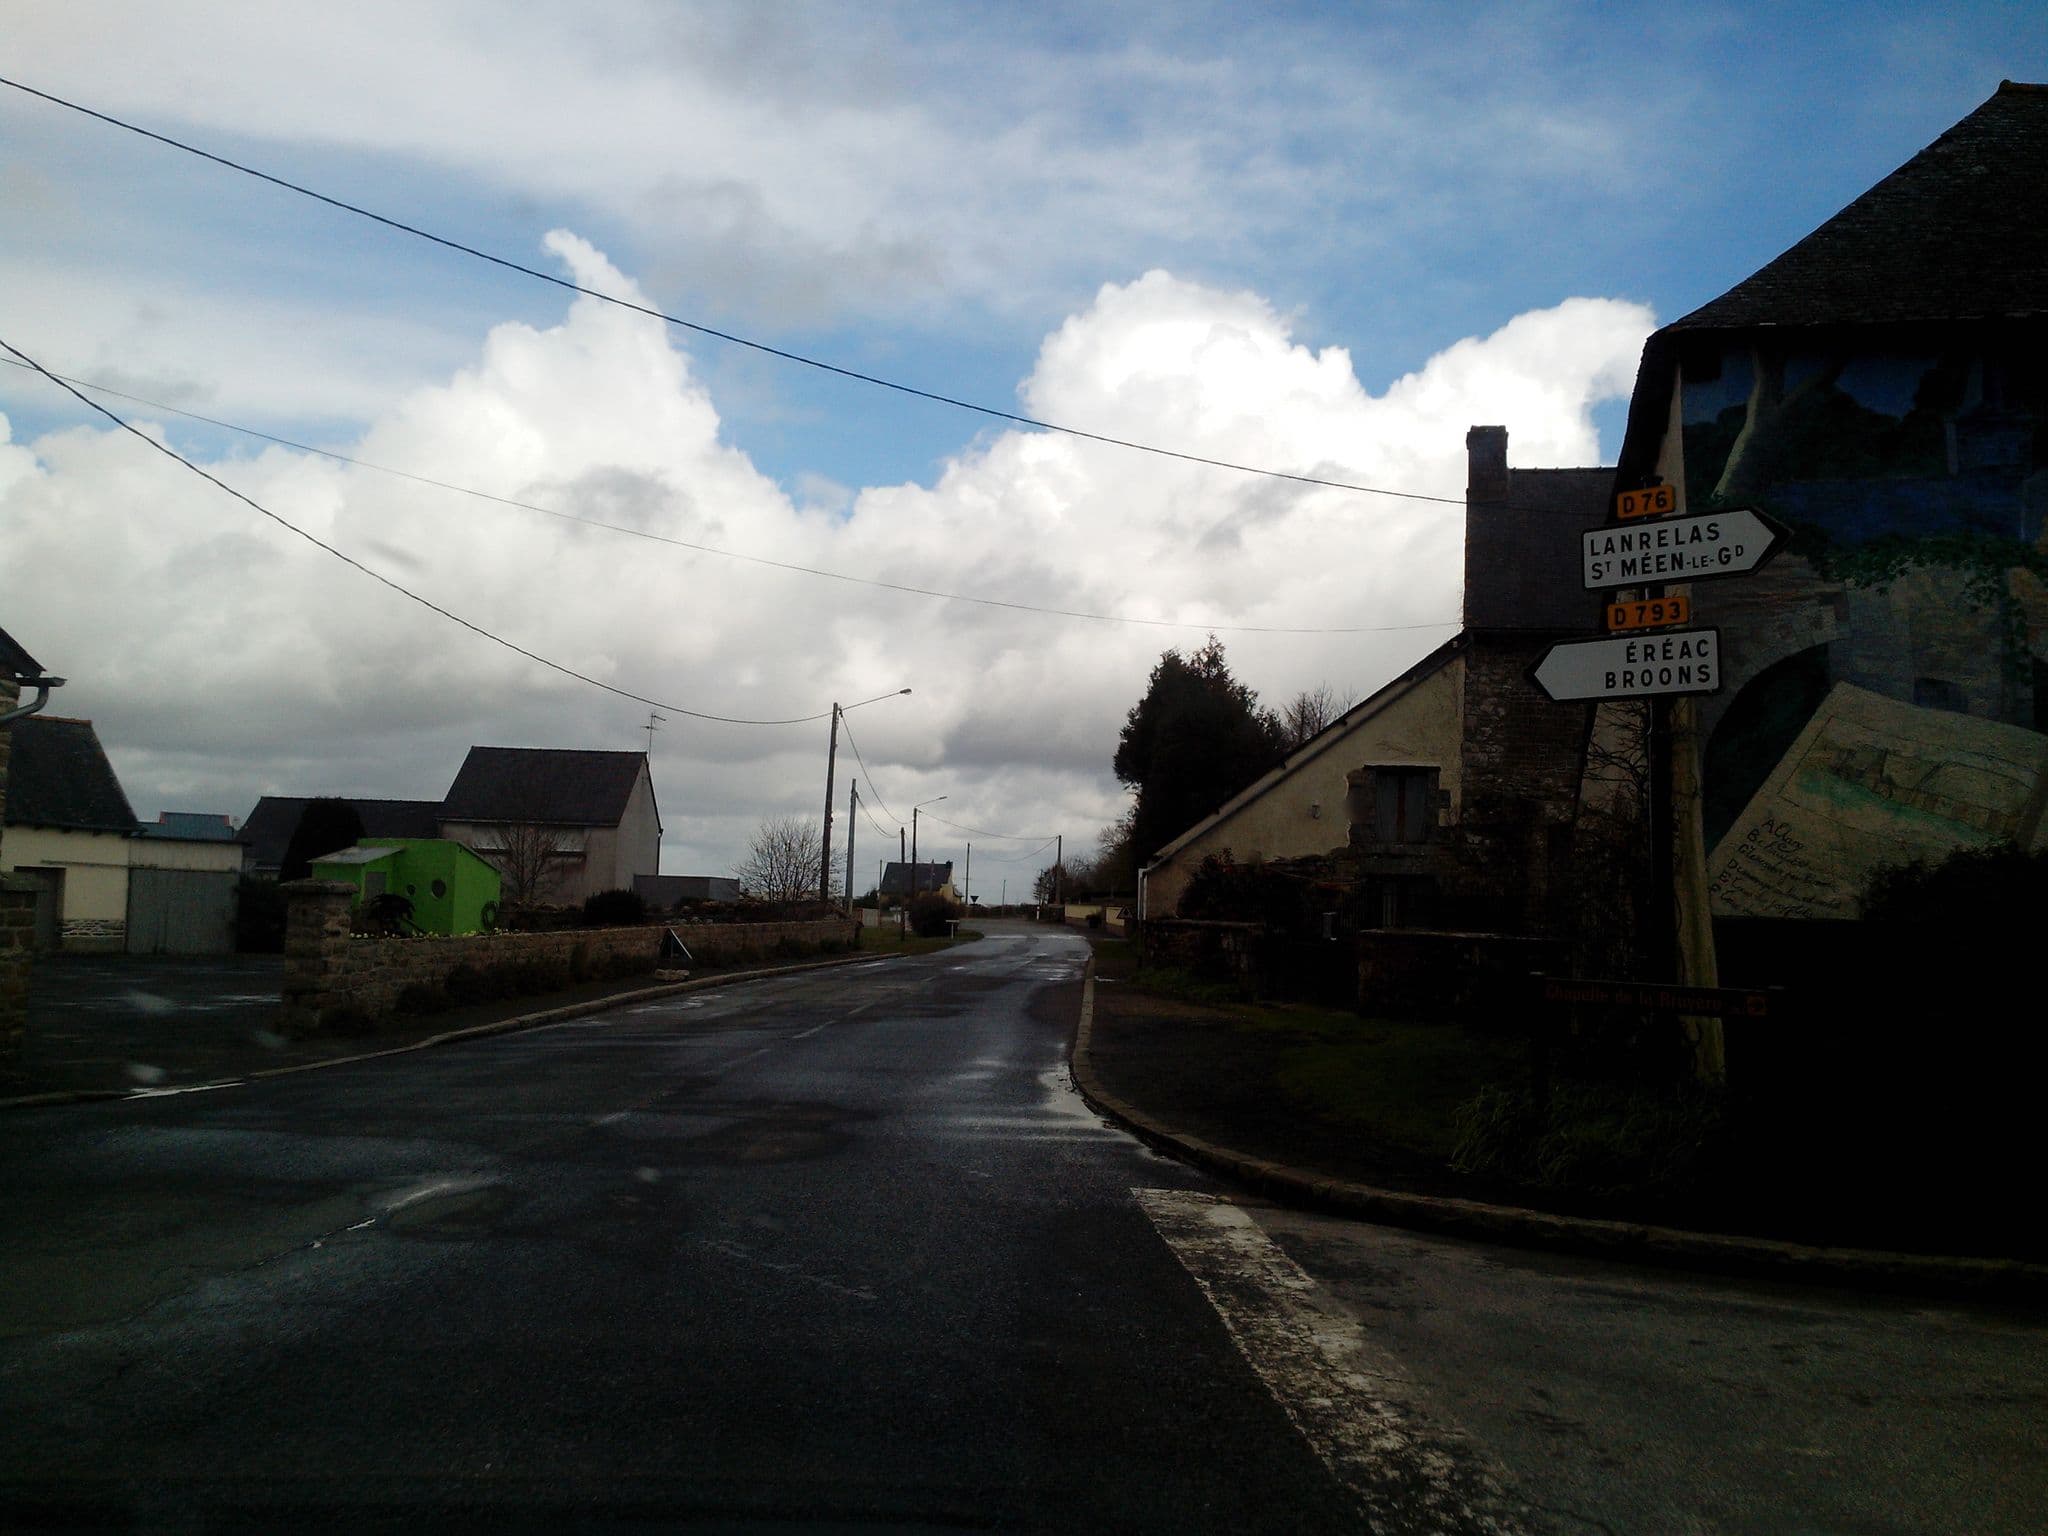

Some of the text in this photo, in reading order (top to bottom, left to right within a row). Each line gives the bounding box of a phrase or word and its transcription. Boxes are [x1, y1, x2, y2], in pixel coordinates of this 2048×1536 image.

[1623, 491, 1667, 513] D 76
[1590, 523, 1720, 556] LANRELAS
[1615, 602, 1681, 625] D 793
[1626, 638, 1709, 663] ÉRÉAC
[1605, 665, 1710, 689] BROONS
